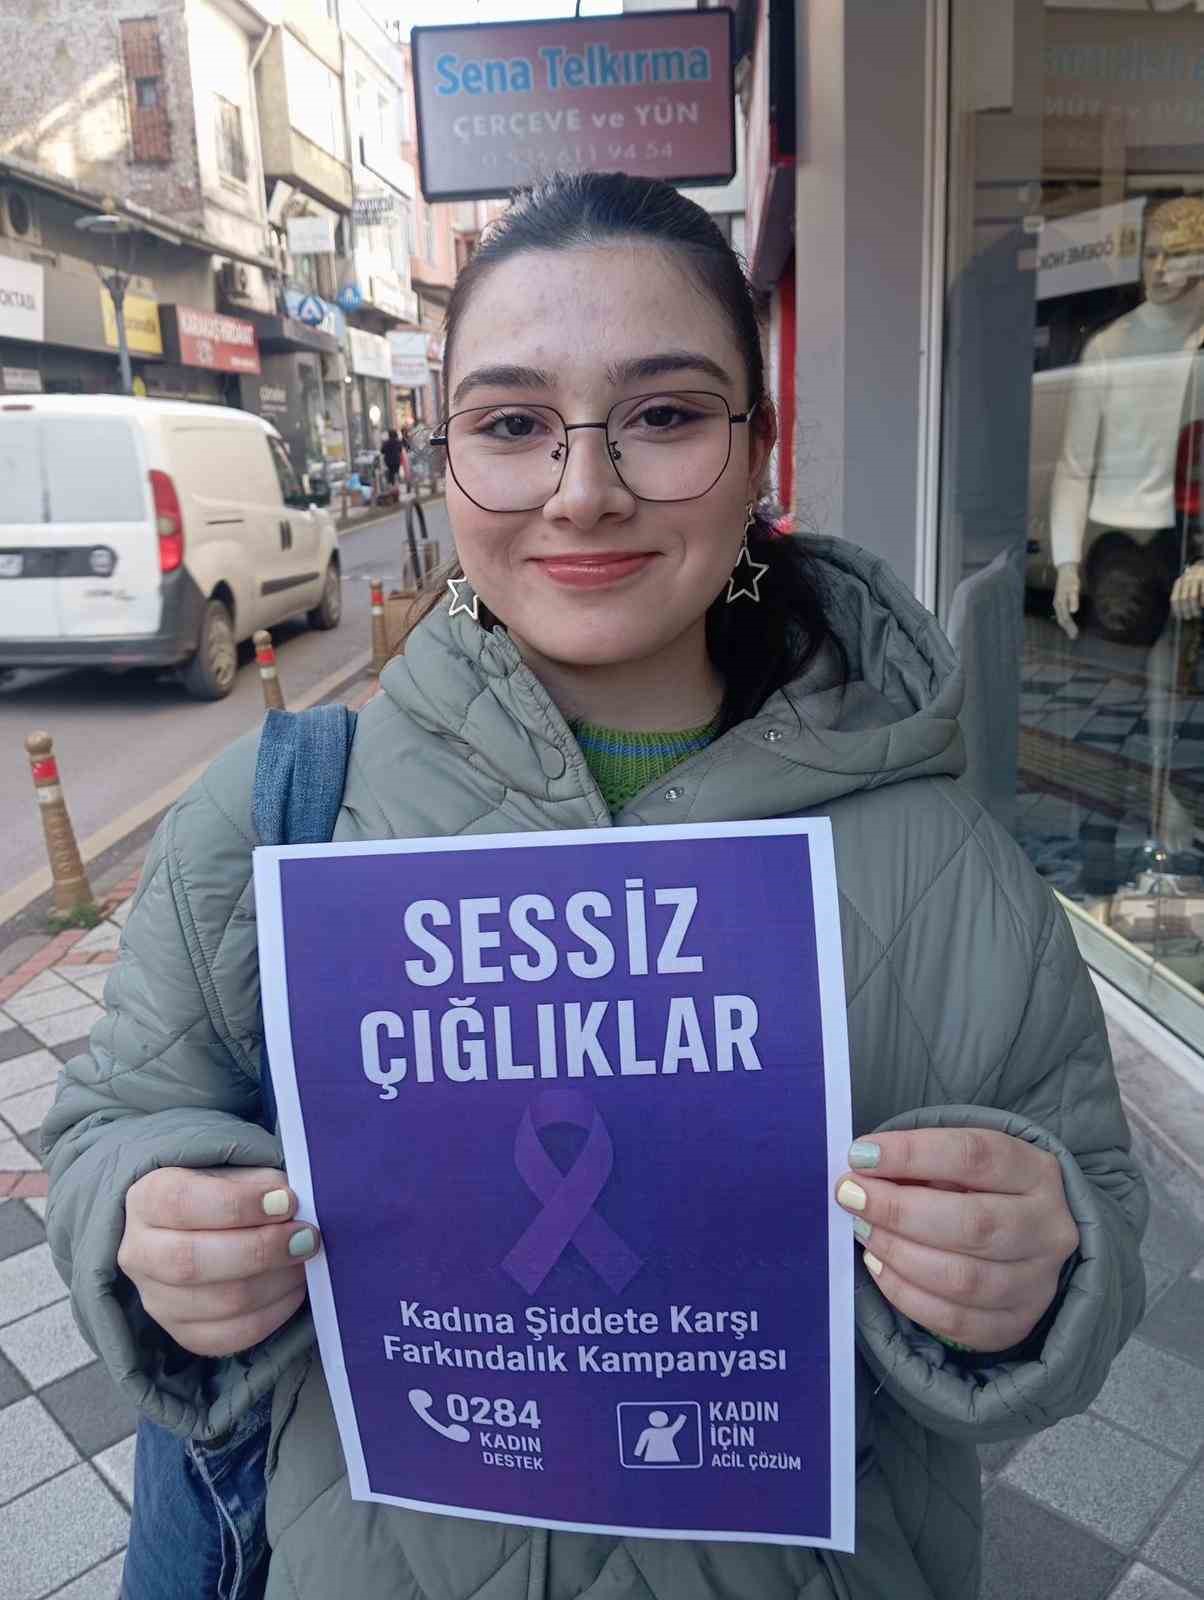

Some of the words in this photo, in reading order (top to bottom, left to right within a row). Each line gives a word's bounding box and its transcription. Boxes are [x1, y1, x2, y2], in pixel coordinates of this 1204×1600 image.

[435, 51, 534, 97] Sena
[539, 44, 713, 89] Telkırma
[453, 109, 582, 143] ÇERÇEVE
[592, 112, 625, 129] ve
[634, 97, 699, 126] YÜN
[403, 878, 704, 987] SESSİZ
[360, 994, 763, 1100] ÇIĞLIKLAR
[399, 1300, 515, 1335] Kadına
[525, 1307, 659, 1342] Şiddete
[670, 1304, 759, 1340] Karşı
[383, 1334, 569, 1373] Farkındalık
[578, 1346, 787, 1379] Kampanyası
[446, 1393, 542, 1430] 0284
[708, 1400, 779, 1423] KADIN
[479, 1431, 542, 1453] KADIN
[710, 1423, 755, 1451] İÇİN
[482, 1451, 545, 1472] DESTEK
[711, 1451, 745, 1468] ACİL
[748, 1450, 802, 1472] ÇÖZÜM
